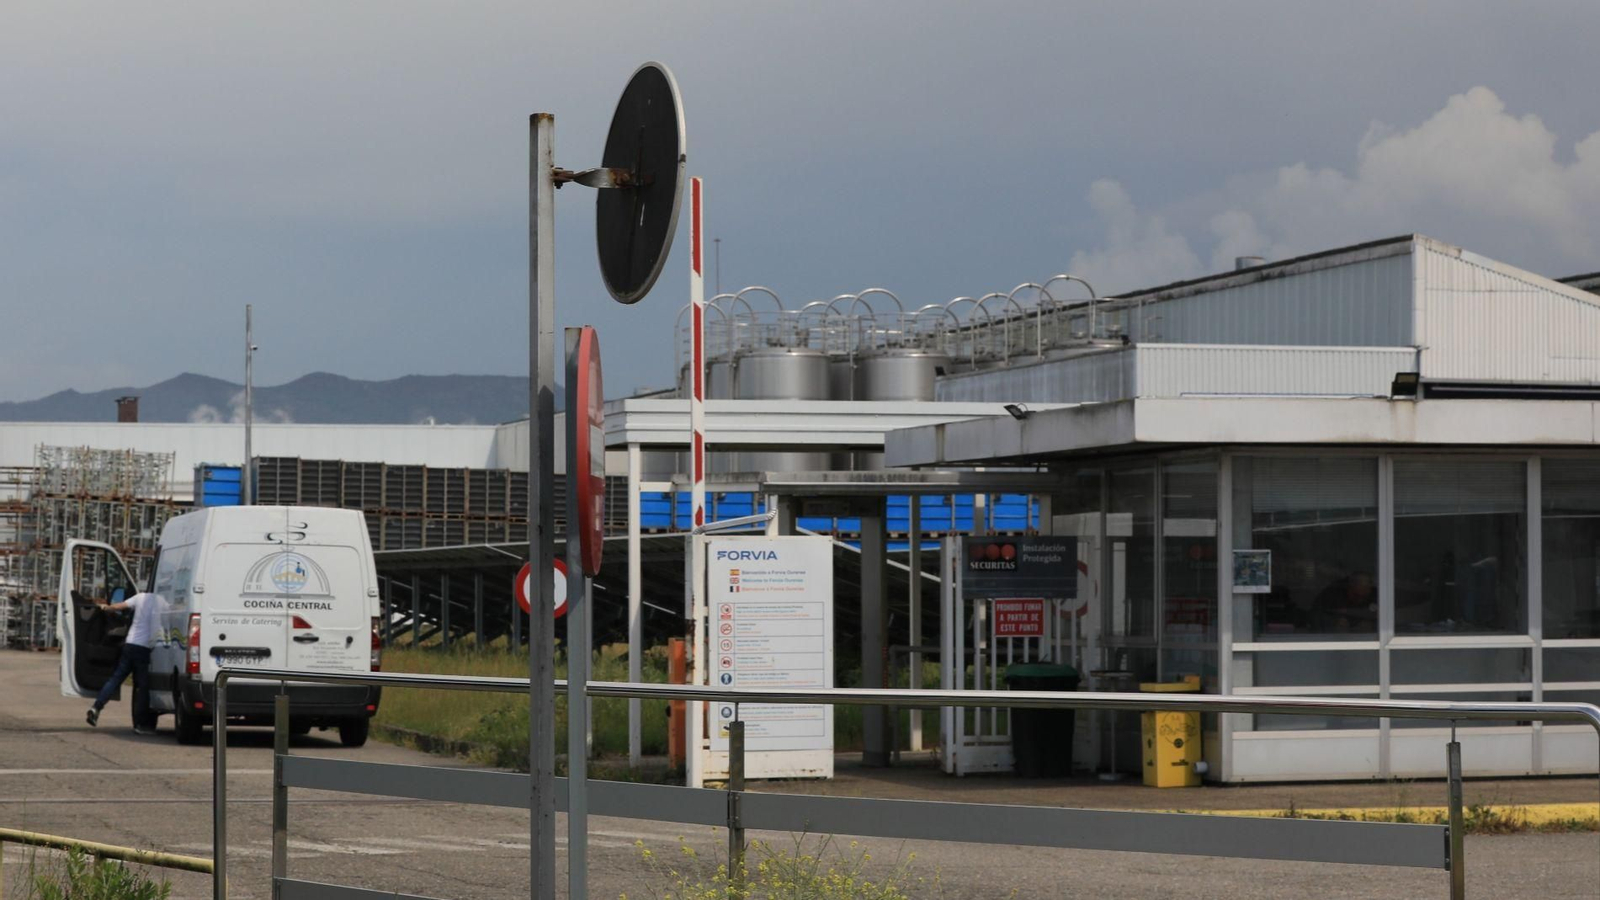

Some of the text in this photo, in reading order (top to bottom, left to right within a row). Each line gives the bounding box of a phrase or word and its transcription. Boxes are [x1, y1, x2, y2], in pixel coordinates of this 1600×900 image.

[1023, 544, 1066, 552] Instalación
[717, 551, 778, 560] FORVIA
[1023, 554, 1062, 563] Protegida
[970, 562, 1016, 570] SECURITAS
[243, 599, 333, 610] COCIÑA CENTRAL
[1024, 603, 1041, 611] FUMAR
[1031, 613, 1039, 621] DE
[212, 617, 238, 625] Servizo
[252, 618, 282, 627] Catering
